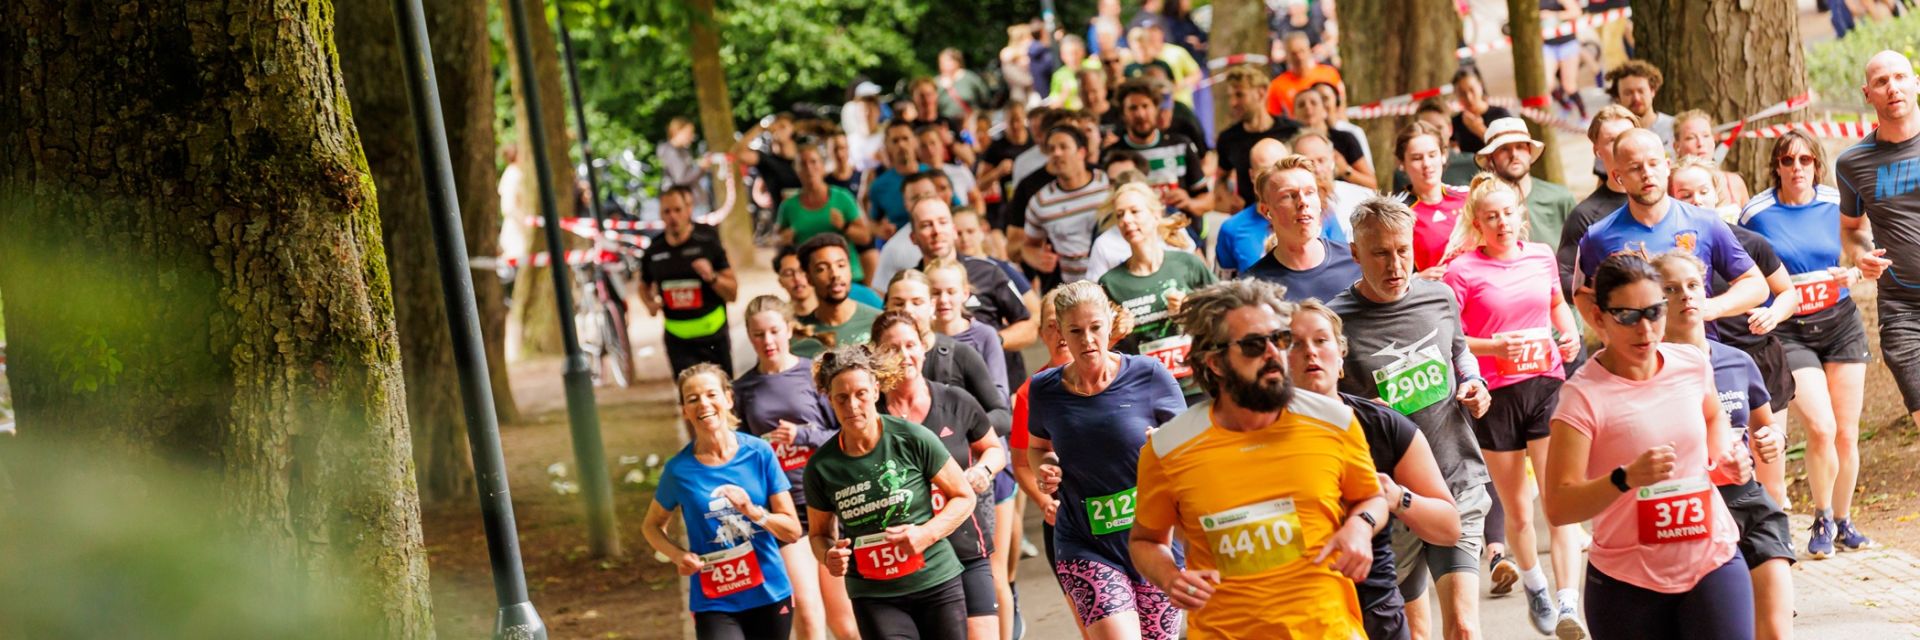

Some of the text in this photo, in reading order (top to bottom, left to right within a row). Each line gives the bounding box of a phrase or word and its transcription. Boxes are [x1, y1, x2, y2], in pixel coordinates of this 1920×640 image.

[1153, 347, 1185, 370] 75
[1517, 361, 1539, 372] LENA
[1386, 364, 1443, 404] 2908
[835, 480, 872, 500] DWARS
[838, 493, 866, 510] DOOR
[841, 492, 905, 520] GRONINGEN
[1091, 491, 1137, 520] 212
[1655, 497, 1705, 528] 373
[1218, 519, 1294, 558] 4410
[1657, 524, 1708, 539] MARTINA
[711, 559, 750, 583] 434
[885, 566, 899, 576] AN
